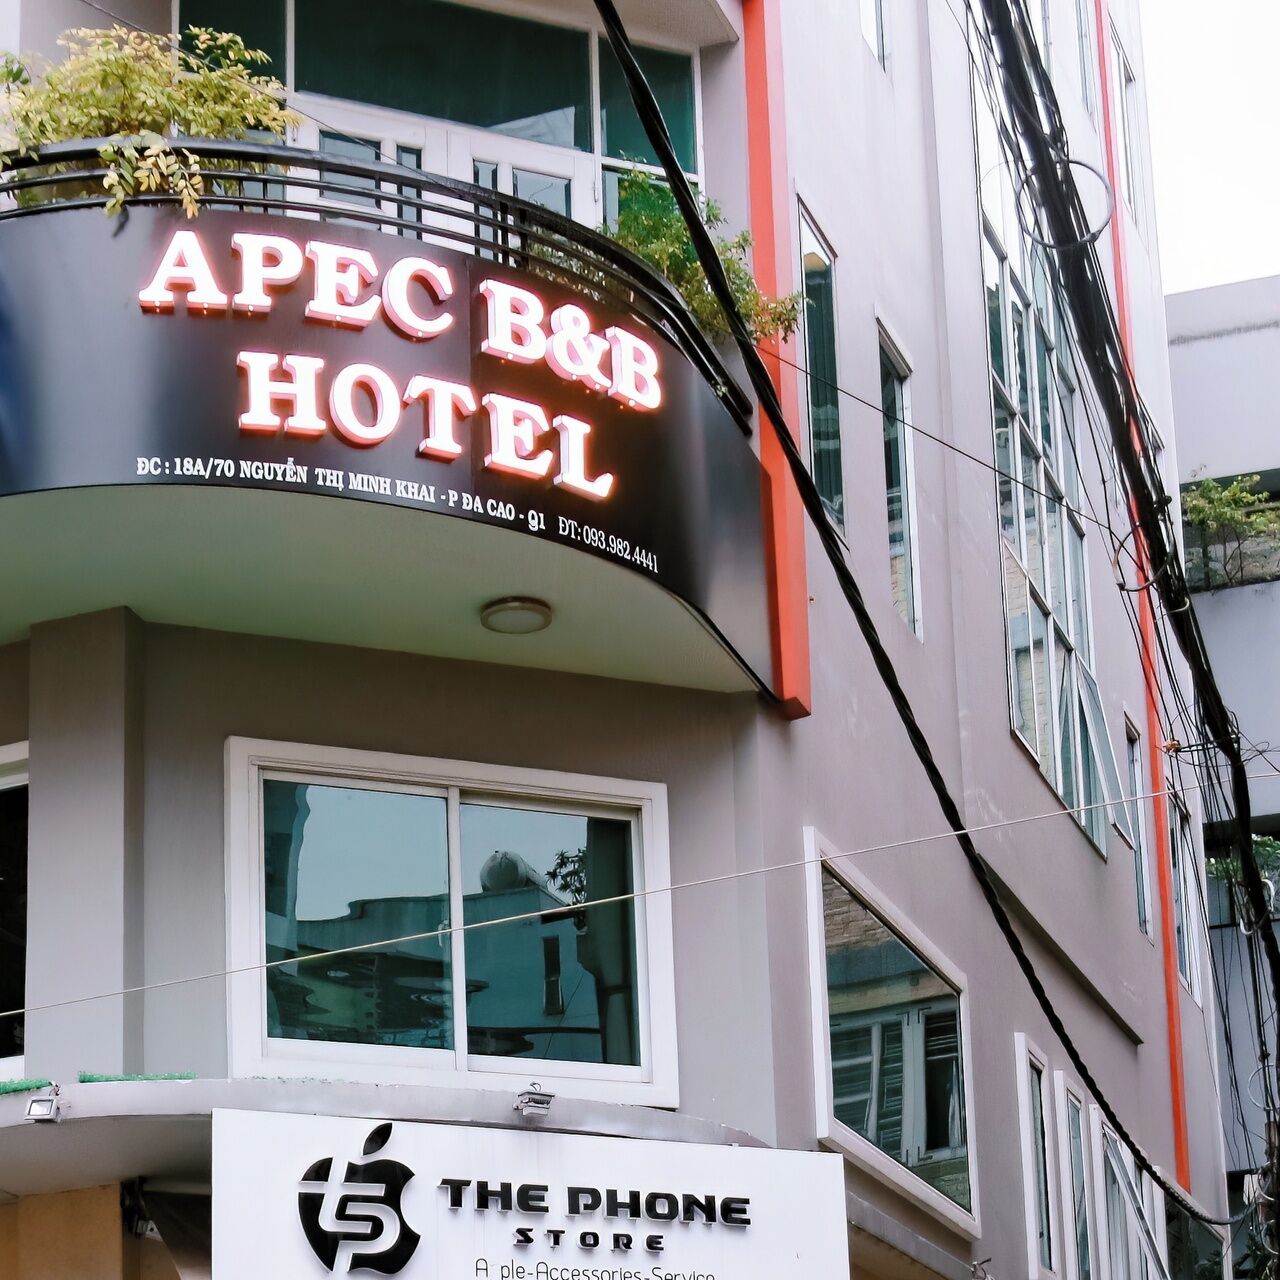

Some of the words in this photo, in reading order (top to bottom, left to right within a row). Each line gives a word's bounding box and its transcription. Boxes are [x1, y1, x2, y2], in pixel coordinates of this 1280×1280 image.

[138, 229, 456, 340] APEC
[478, 278, 663, 412] B&B
[236, 350, 618, 500] HOTEL
[173, 457, 236, 480] 18A/70
[314, 467, 344, 491] THỊ
[348, 471, 393, 496] MINH
[395, 479, 436, 504] KHAI
[461, 492, 485, 514] ĐA
[486, 498, 516, 521] CAO
[582, 524, 659, 574] 093.982.4441
[436, 1177, 550, 1215] THE
[566, 1184, 752, 1228] PHONE
[511, 1227, 666, 1253] STORE
